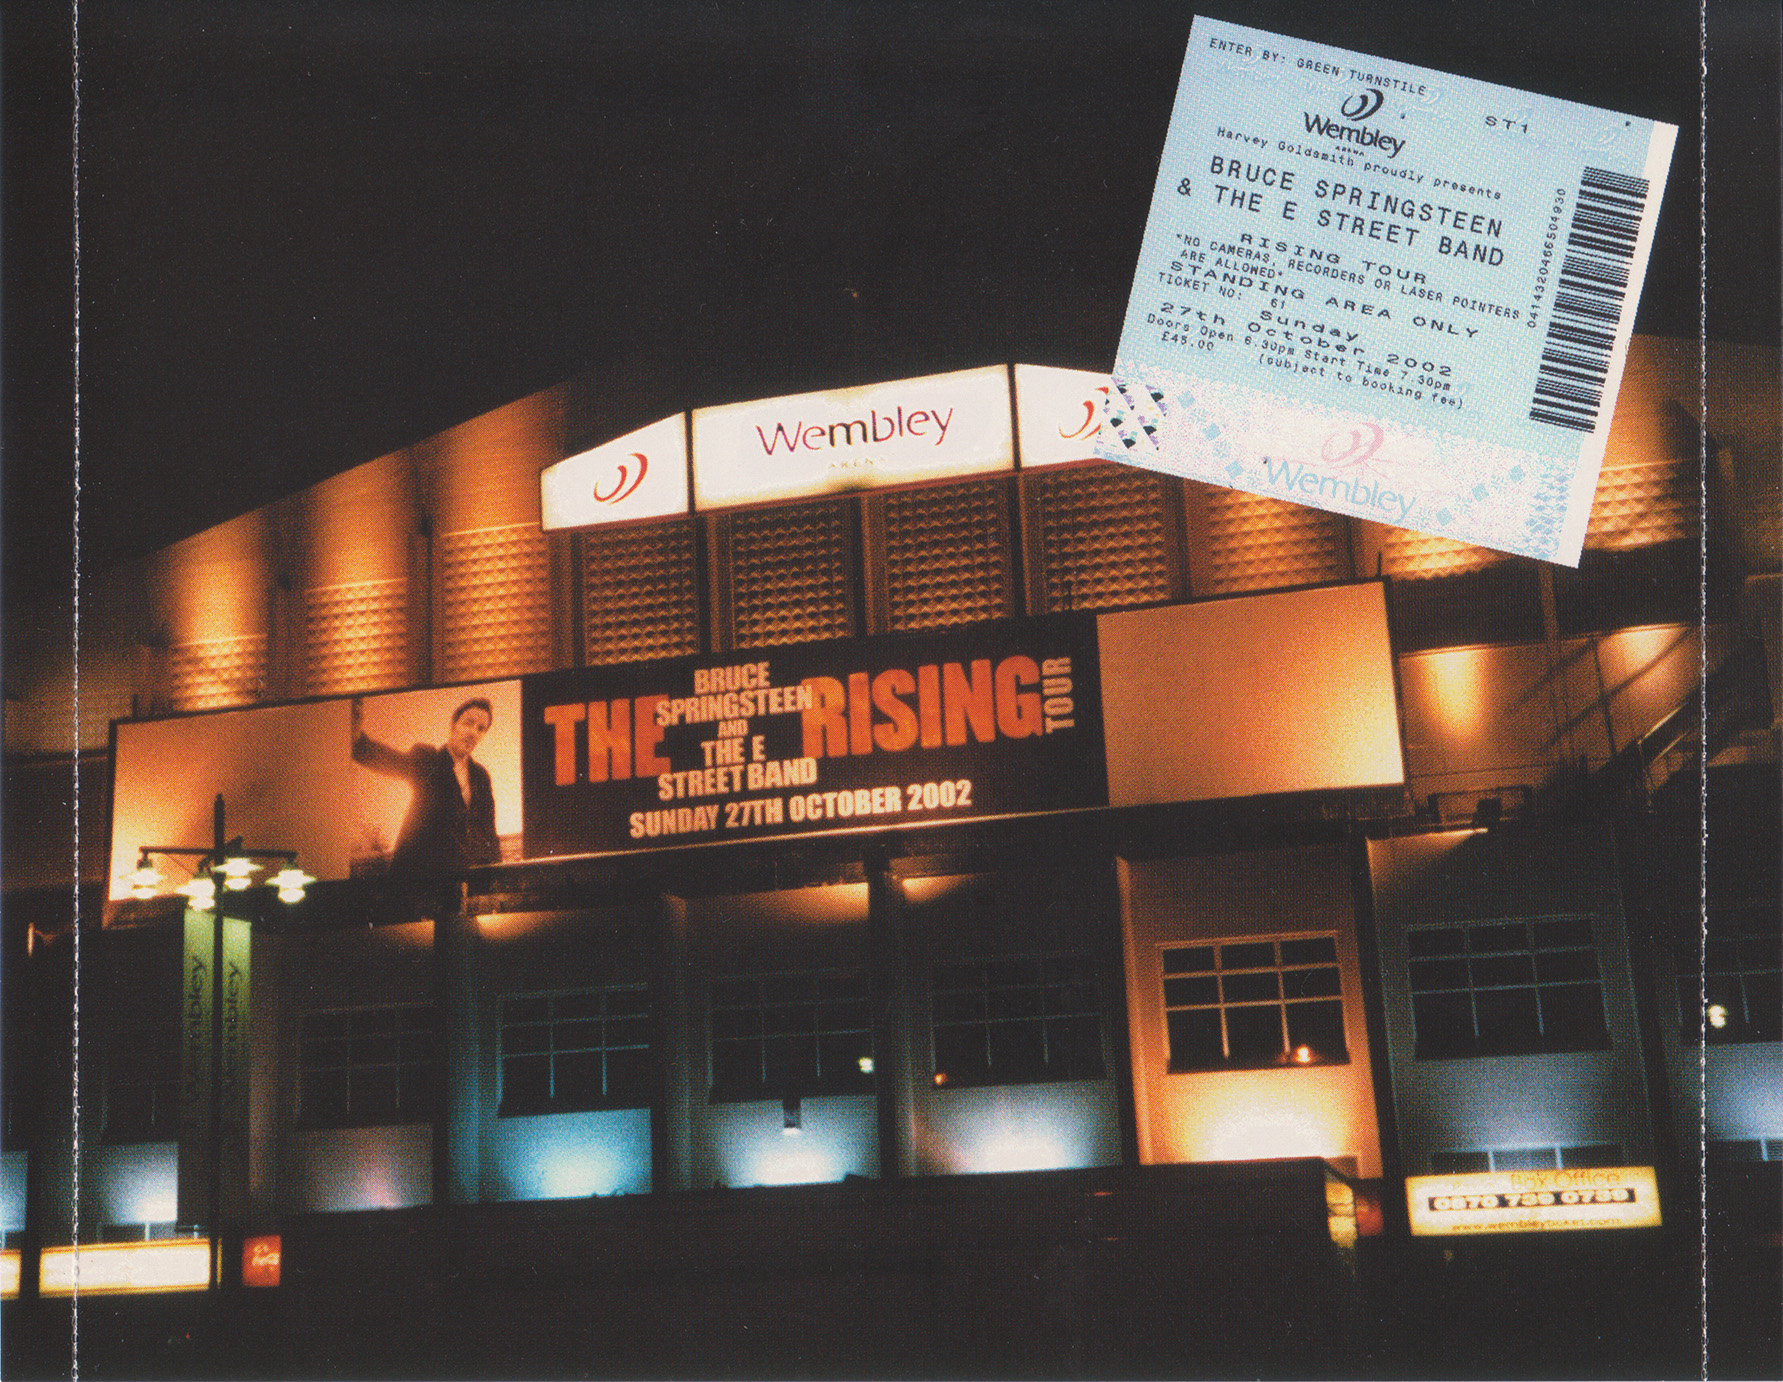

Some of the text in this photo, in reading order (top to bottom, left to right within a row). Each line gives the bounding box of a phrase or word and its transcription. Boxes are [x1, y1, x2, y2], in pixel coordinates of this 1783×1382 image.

[1210, 38, 1252, 56] ENTER
[1262, 50, 1285, 61] BY:
[1297, 58, 1339, 76] GREEN
[1350, 70, 1426, 95] TURNSTILE
[1304, 112, 1405, 158] Wembley
[1485, 116, 1527, 133] ST1
[1217, 127, 1500, 199] Harvey Goldsmith proudly presents
[1177, 178, 1504, 266] & THE E STREET BAND
[1211, 155, 1502, 238] BRUCE SPRINGSTEEN
[1181, 250, 1205, 263] ARE
[1241, 234, 1426, 284] RISING TOUR
[1160, 272, 1285, 308] TICKET NO: 61
[1171, 261, 1478, 338] STANDING AREA ONLY
[1288, 259, 1364, 284] RECORDERS
[1375, 279, 1390, 290] OR
[1401, 285, 1442, 301] LASER
[1453, 296, 1519, 319] POINTERS
[1148, 313, 1189, 331] Doors
[1201, 326, 1233, 341] Open
[1305, 350, 1345, 365] Start
[1358, 361, 1389, 376] Time
[1161, 303, 1451, 376] 27th October 2002
[1260, 311, 1358, 342] Sunday
[1162, 331, 1213, 350] £45.00
[1338, 372, 1351, 382] to
[1363, 377, 1421, 399] booking
[1433, 393, 1462, 409] fee)
[756, 406, 954, 456] Wembley
[1263, 456, 1416, 524] Wembley
[656, 685, 814, 727] SPRINGSTEEN
[694, 661, 771, 695] BRUCE
[1042, 656, 1075, 735] TOUR
[543, 655, 1042, 786] THE RISING
[717, 719, 749, 739] AND
[657, 757, 818, 802] STREET BAND
[701, 735, 766, 768] THE E
[629, 780, 973, 839] SUNDAY 27TH OCTOBER 2002
